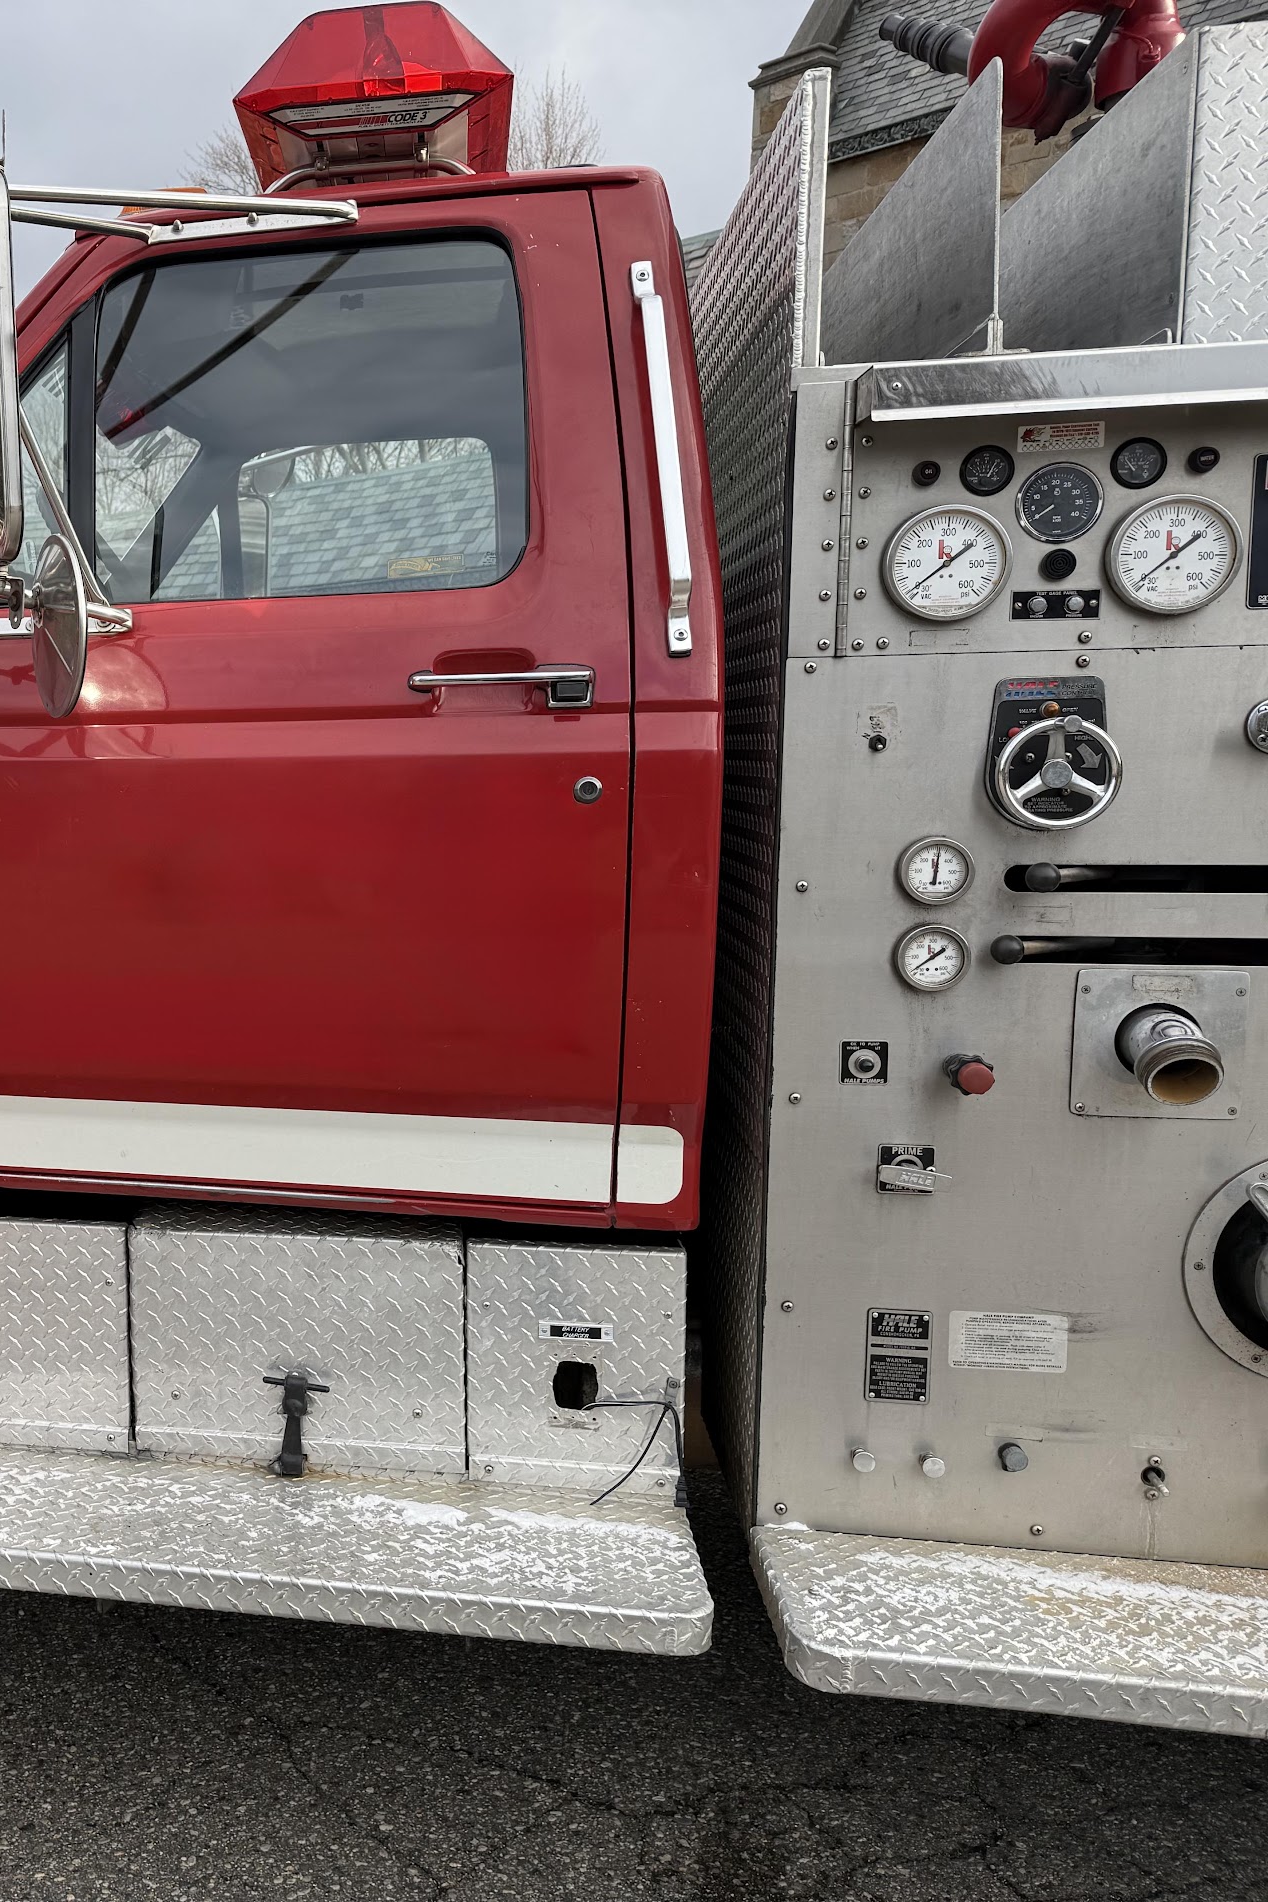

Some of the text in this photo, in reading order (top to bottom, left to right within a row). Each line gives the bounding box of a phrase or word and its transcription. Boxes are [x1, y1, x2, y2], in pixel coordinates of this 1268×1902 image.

[387, 111, 428, 123] CODE 3
[1168, 518, 1186, 528] 300
[941, 528, 957, 537] 300
[1143, 530, 1160, 539] 200
[917, 539, 932, 548] 200
[1133, 550, 1148, 560] 100
[1198, 551, 1214, 561] 500
[907, 559, 921, 569] 100
[969, 559, 985, 569] 500
[1186, 572, 1203, 581] 600
[958, 580, 974, 589] 600
[1188, 583, 1199, 592] psi
[960, 589, 970, 599] psi
[892, 1146, 923, 1156] PRIME
[899, 1171, 932, 1186] HALE
[882, 1314, 919, 1328] HALE
[878, 1380, 917, 1388] LUBRICATION
